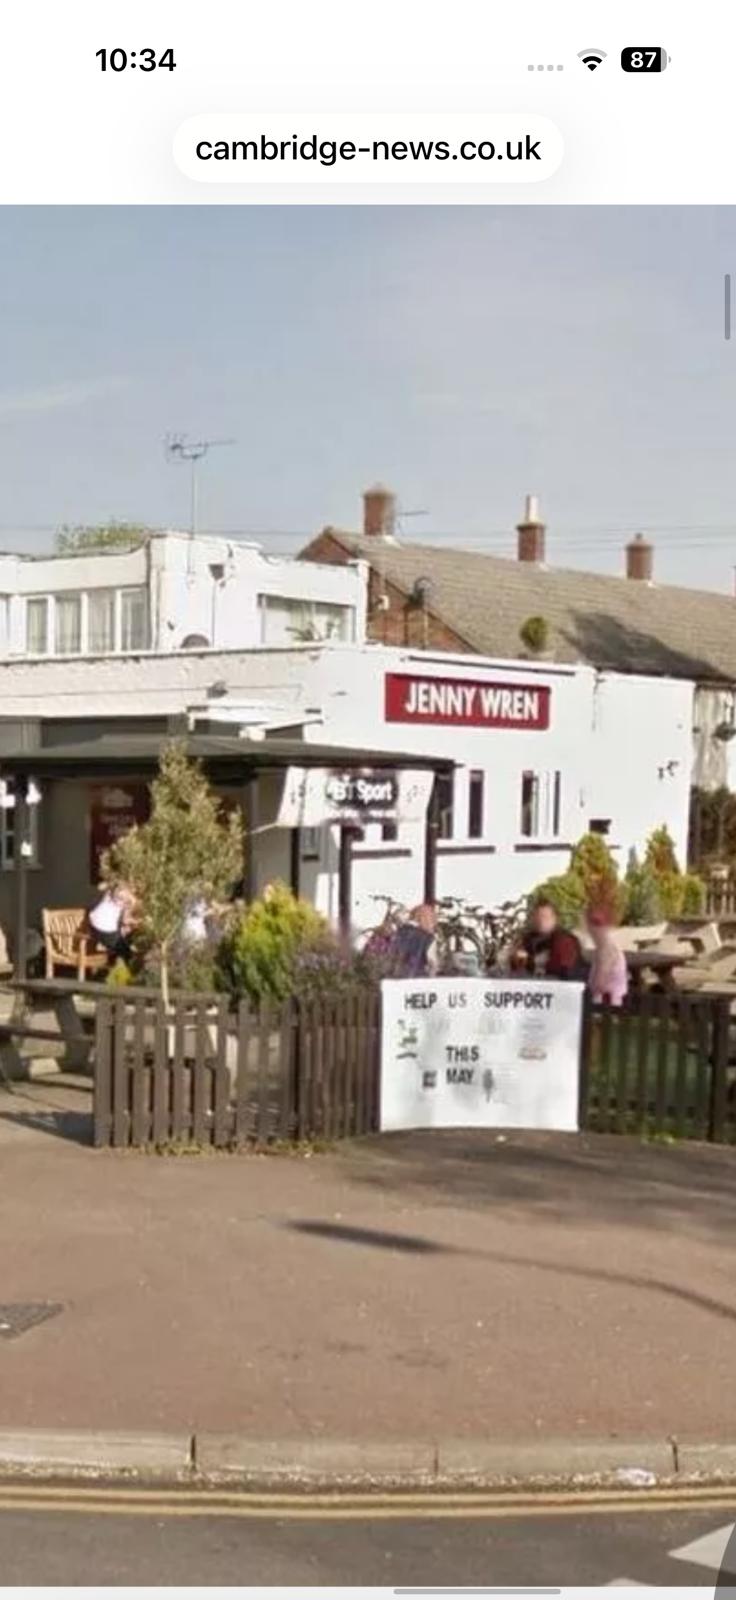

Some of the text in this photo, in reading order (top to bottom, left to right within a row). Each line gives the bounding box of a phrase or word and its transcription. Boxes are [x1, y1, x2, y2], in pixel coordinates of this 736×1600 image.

[405, 682, 540, 721] JENNY WREN
[356, 778, 392, 804] Sport
[404, 991, 553, 1010] HELP US SUPPORT
[446, 1046, 480, 1063] THIS
[446, 1069, 475, 1085] MAY
